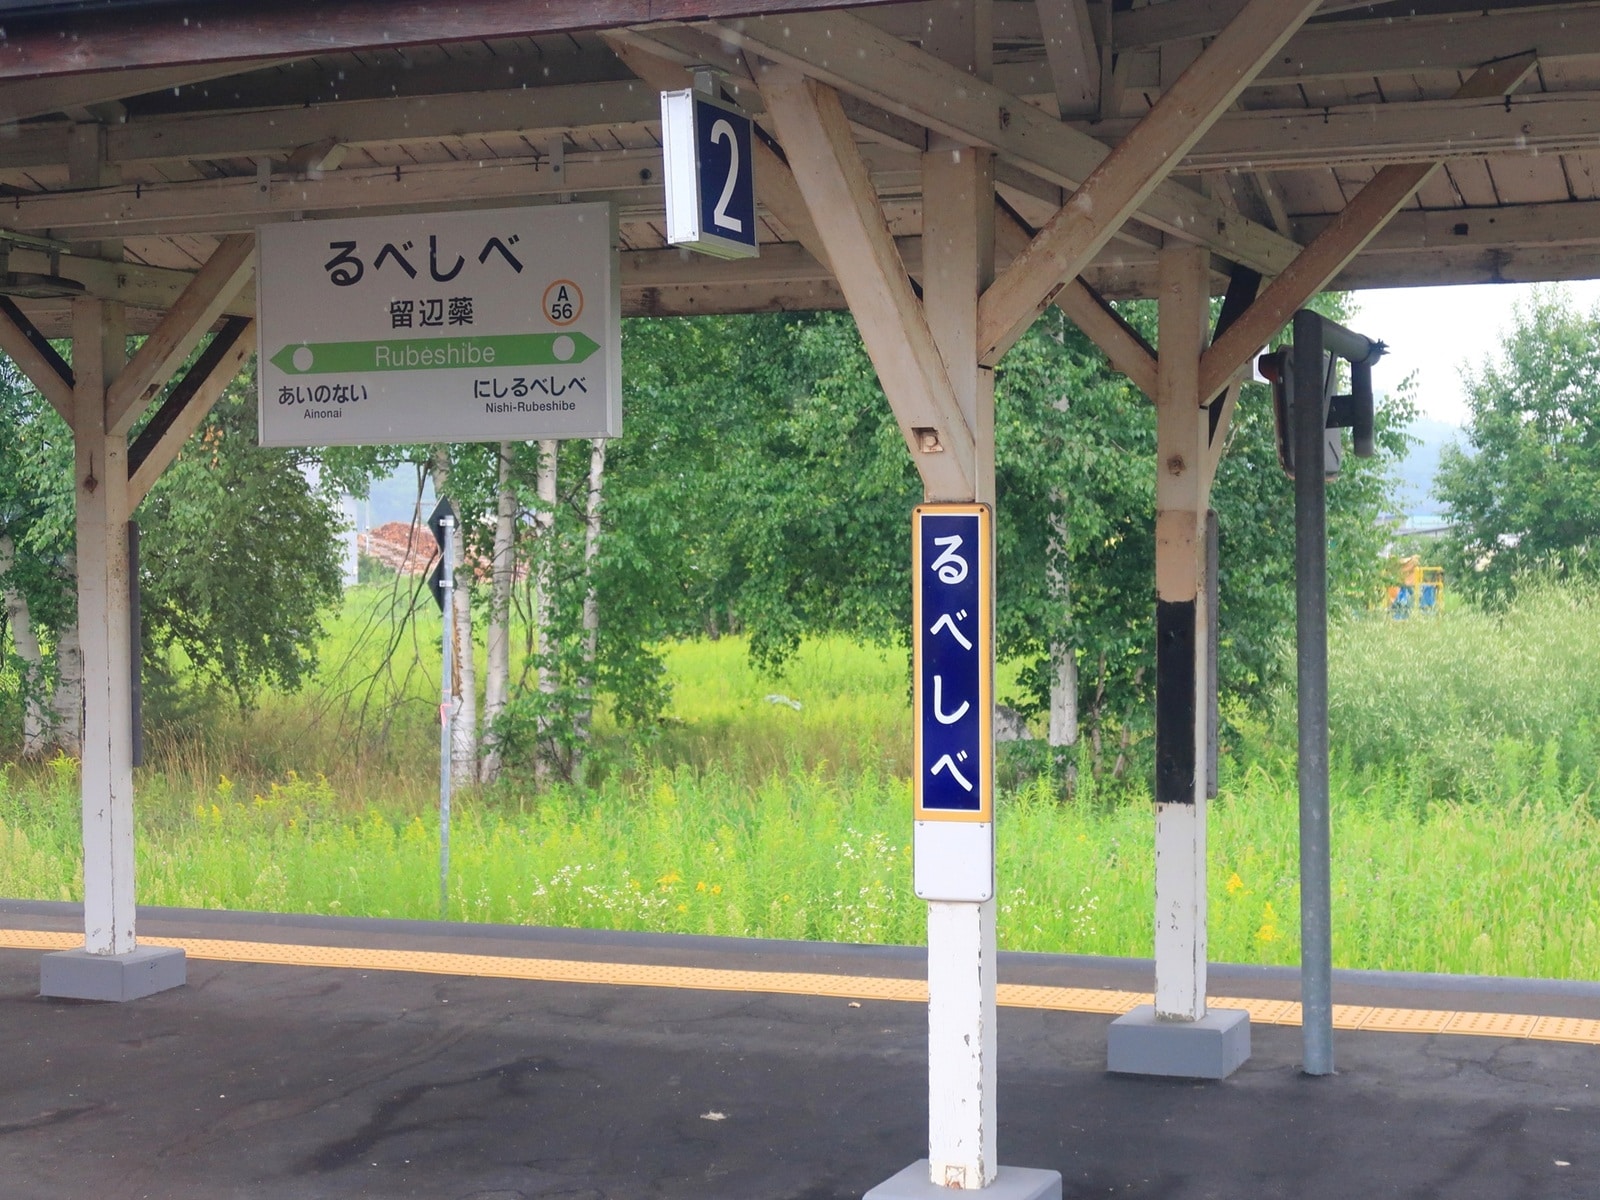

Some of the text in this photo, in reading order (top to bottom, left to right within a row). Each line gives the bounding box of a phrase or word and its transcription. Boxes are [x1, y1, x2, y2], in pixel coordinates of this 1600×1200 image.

[710, 119, 742, 233] 2
[324, 234, 524, 287] るべしべ
[557, 286, 568, 302] A
[390, 297, 474, 329] 留辺蘂
[551, 304, 573, 320] 56
[375, 342, 496, 367] Rubeshibe
[278, 383, 368, 406] あいのない
[474, 376, 588, 400] にしるべしべ
[303, 407, 343, 420] Ainonai
[485, 400, 576, 414] Nishi-Rubeshibe
[930, 534, 973, 792] るべしべ
